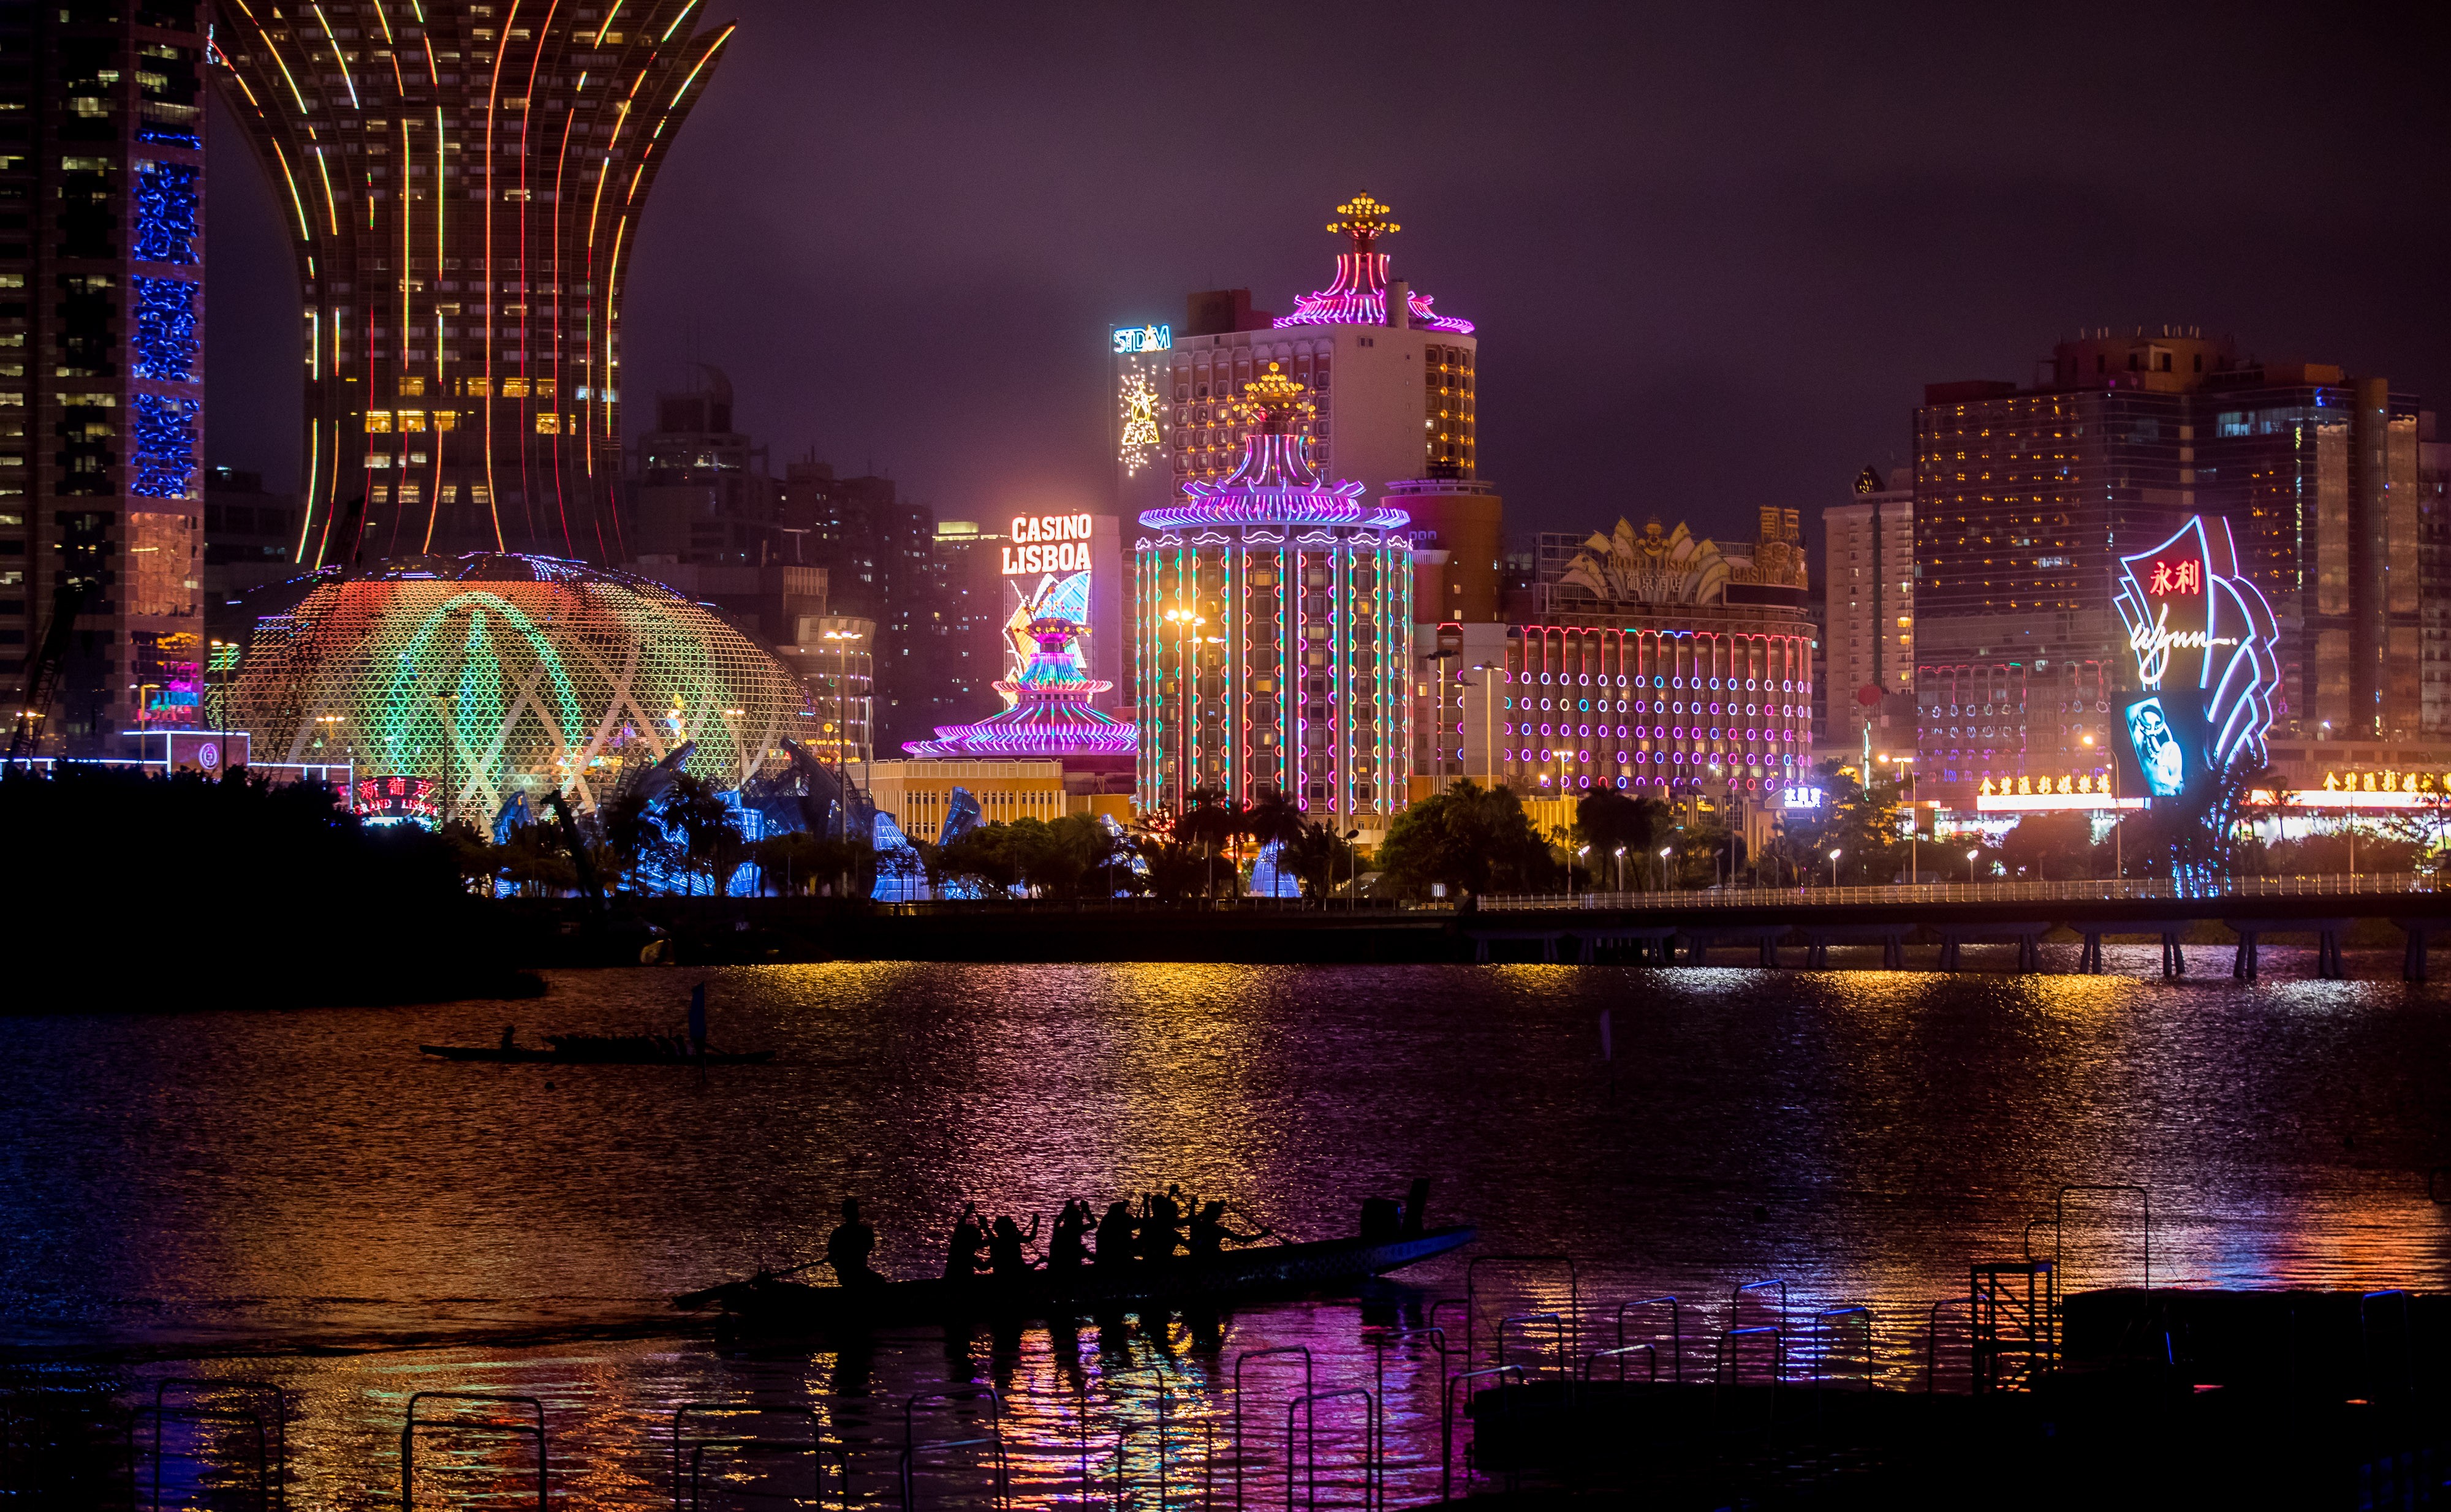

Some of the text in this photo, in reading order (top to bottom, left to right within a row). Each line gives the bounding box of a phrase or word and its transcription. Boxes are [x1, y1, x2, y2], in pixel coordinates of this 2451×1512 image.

[1012, 513, 1092, 543] CASINO
[1002, 542, 1092, 575] LISBOA
[1608, 556, 1651, 570] HOTEL
[1626, 572, 1681, 592] 葡京酒店
[2150, 560, 2200, 596] 永利
[359, 777, 433, 799] 新葡京
[354, 799, 438, 816] GRAND LISBOA
